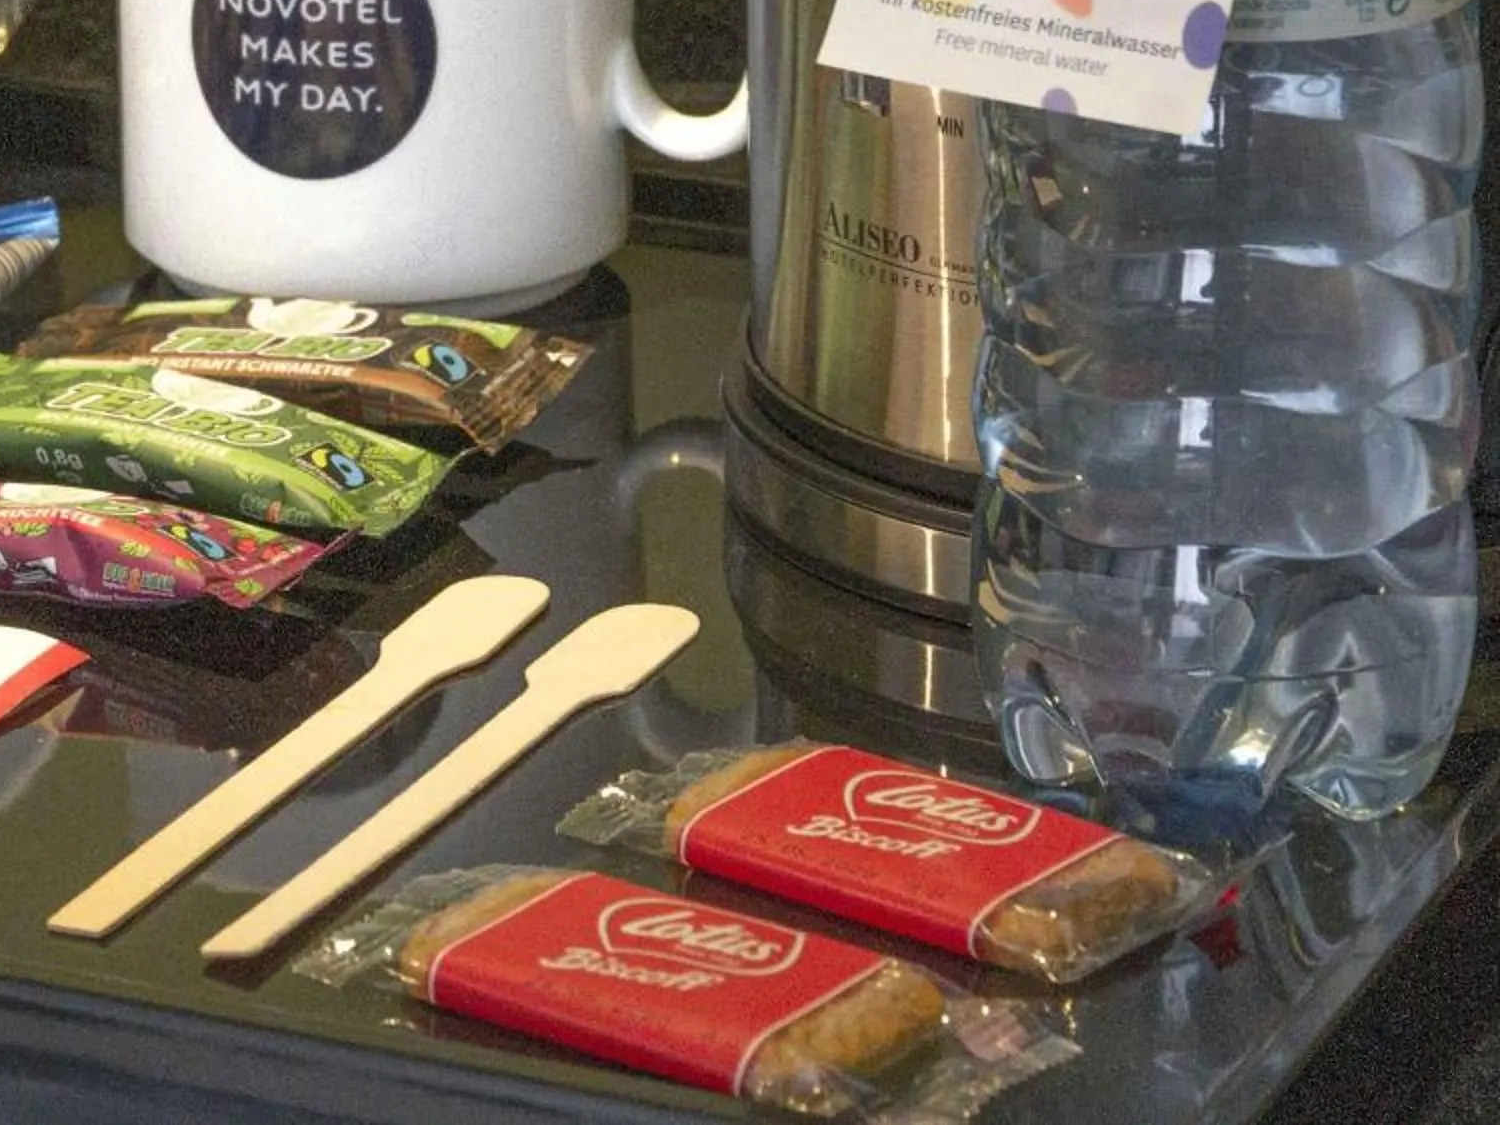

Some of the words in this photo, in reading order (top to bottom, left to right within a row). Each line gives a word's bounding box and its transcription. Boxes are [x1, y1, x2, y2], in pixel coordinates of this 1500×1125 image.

[240, 33, 376, 69] MAKES
[934, 28, 976, 53] Free
[979, 36, 1049, 67] mineral
[1055, 53, 1109, 77] water
[1036, 17, 1182, 61] Mineralwasser
[233, 75, 289, 107] MY
[301, 83, 385, 114] DAY.
[936, 116, 964, 139] MIN
[822, 202, 921, 265] ALISEO
[47, 382, 178, 421] TEA
[864, 783, 1017, 832] Lotus
[786, 814, 962, 859] Biscoff
[619, 909, 782, 961] Lotus
[538, 945, 725, 992] Biscoff
